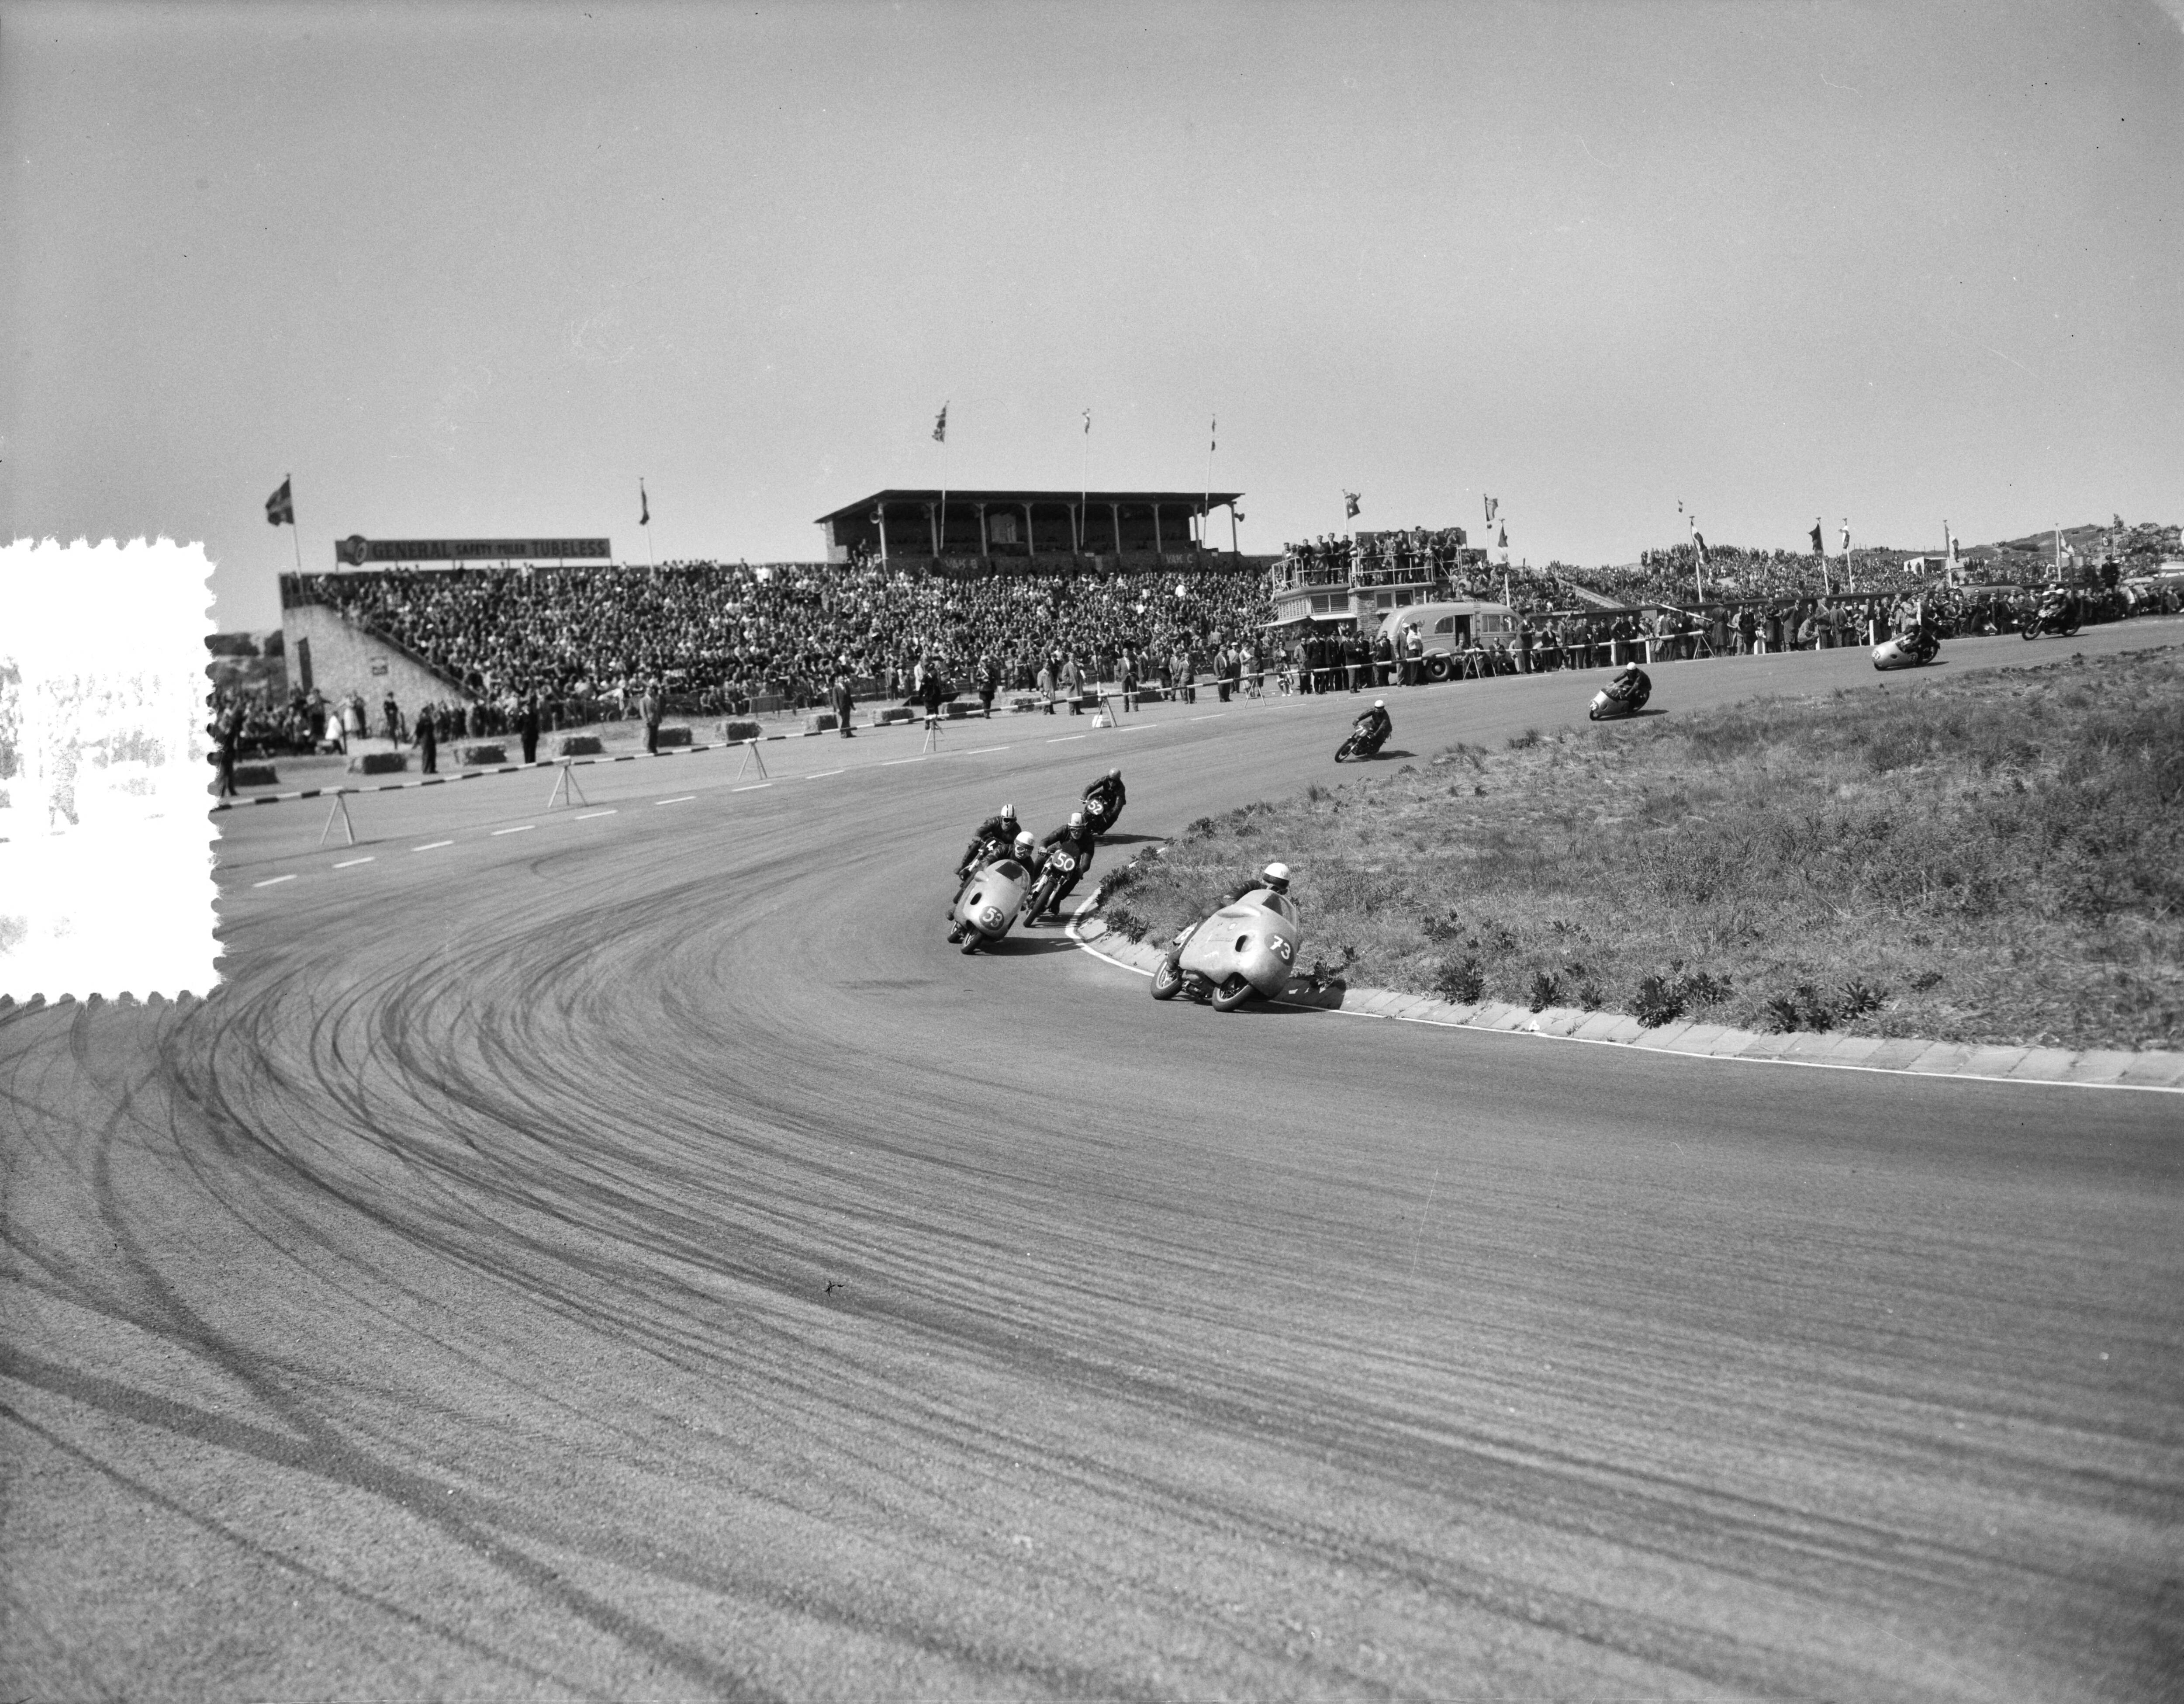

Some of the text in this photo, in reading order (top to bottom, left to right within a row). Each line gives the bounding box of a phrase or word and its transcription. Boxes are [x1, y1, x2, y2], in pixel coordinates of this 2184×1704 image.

[373, 541, 451, 559] GENERAL
[531, 540, 606, 557] TUBELESS
[1166, 553, 1193, 564] VAK C
[944, 559, 966, 569] VAK
[1087, 800, 1102, 815] 52
[1056, 853, 1075, 871] 50
[981, 907, 1003, 928] 53
[1270, 935, 1291, 959] 73
